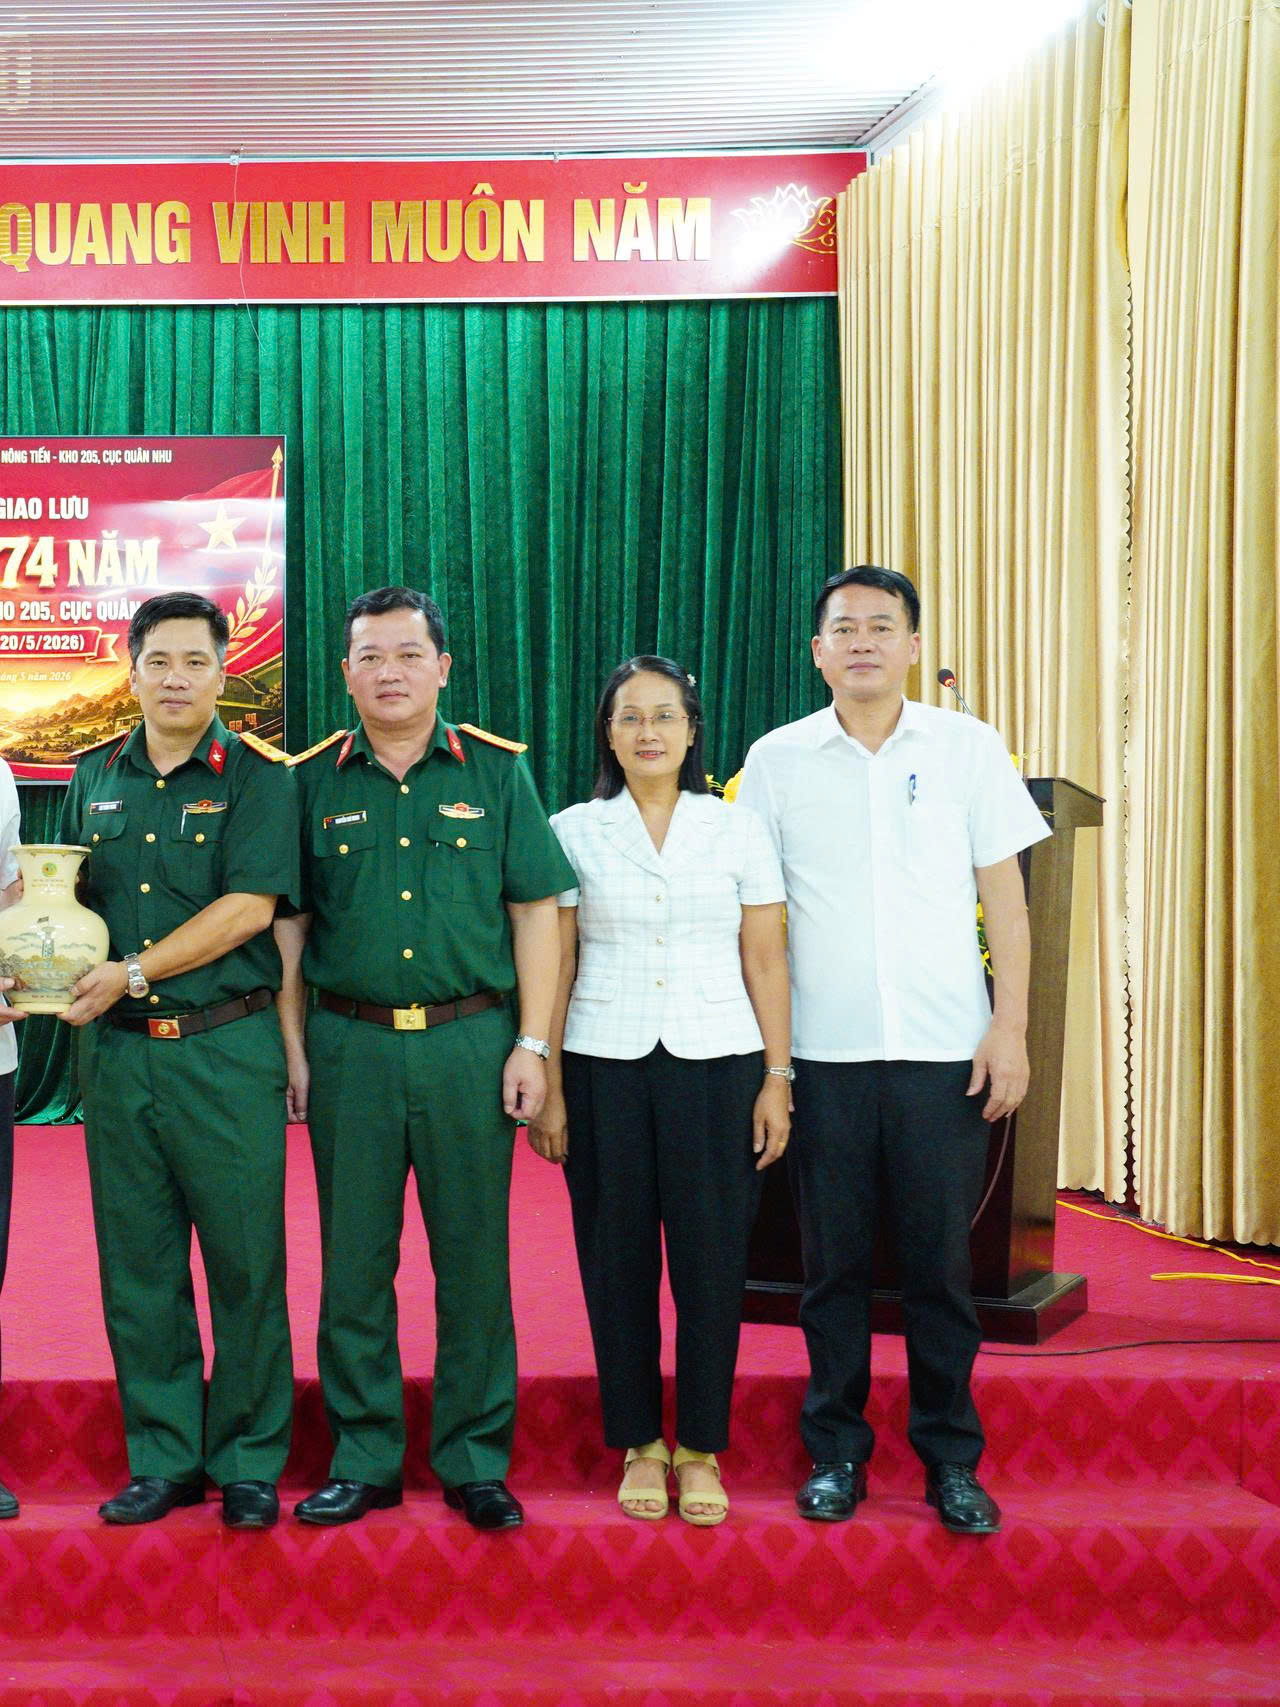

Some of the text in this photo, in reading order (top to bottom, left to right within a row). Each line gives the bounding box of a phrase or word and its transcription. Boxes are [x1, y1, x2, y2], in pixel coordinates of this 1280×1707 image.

[211, 201, 346, 265] VINH
[370, 183, 545, 264] MUÔN
[573, 182, 713, 262] NĂM
[0, 447, 28, 464] NÔNG
[29, 446, 51, 464] TIẾN
[58, 450, 79, 464] KHO
[80, 450, 101, 465] 205,
[102, 450, 122, 466] CỤC
[124, 447, 150, 464] QUÂN
[151, 450, 172, 464] NHU
[48, 495, 89, 520] LƯU
[67, 530, 160, 588] NĂM
[20, 600, 55, 623] 205,
[60, 600, 93, 624] CỤC
[0, 634, 85, 651] 20/5/2026)
[49, 671, 72, 681] 2026
